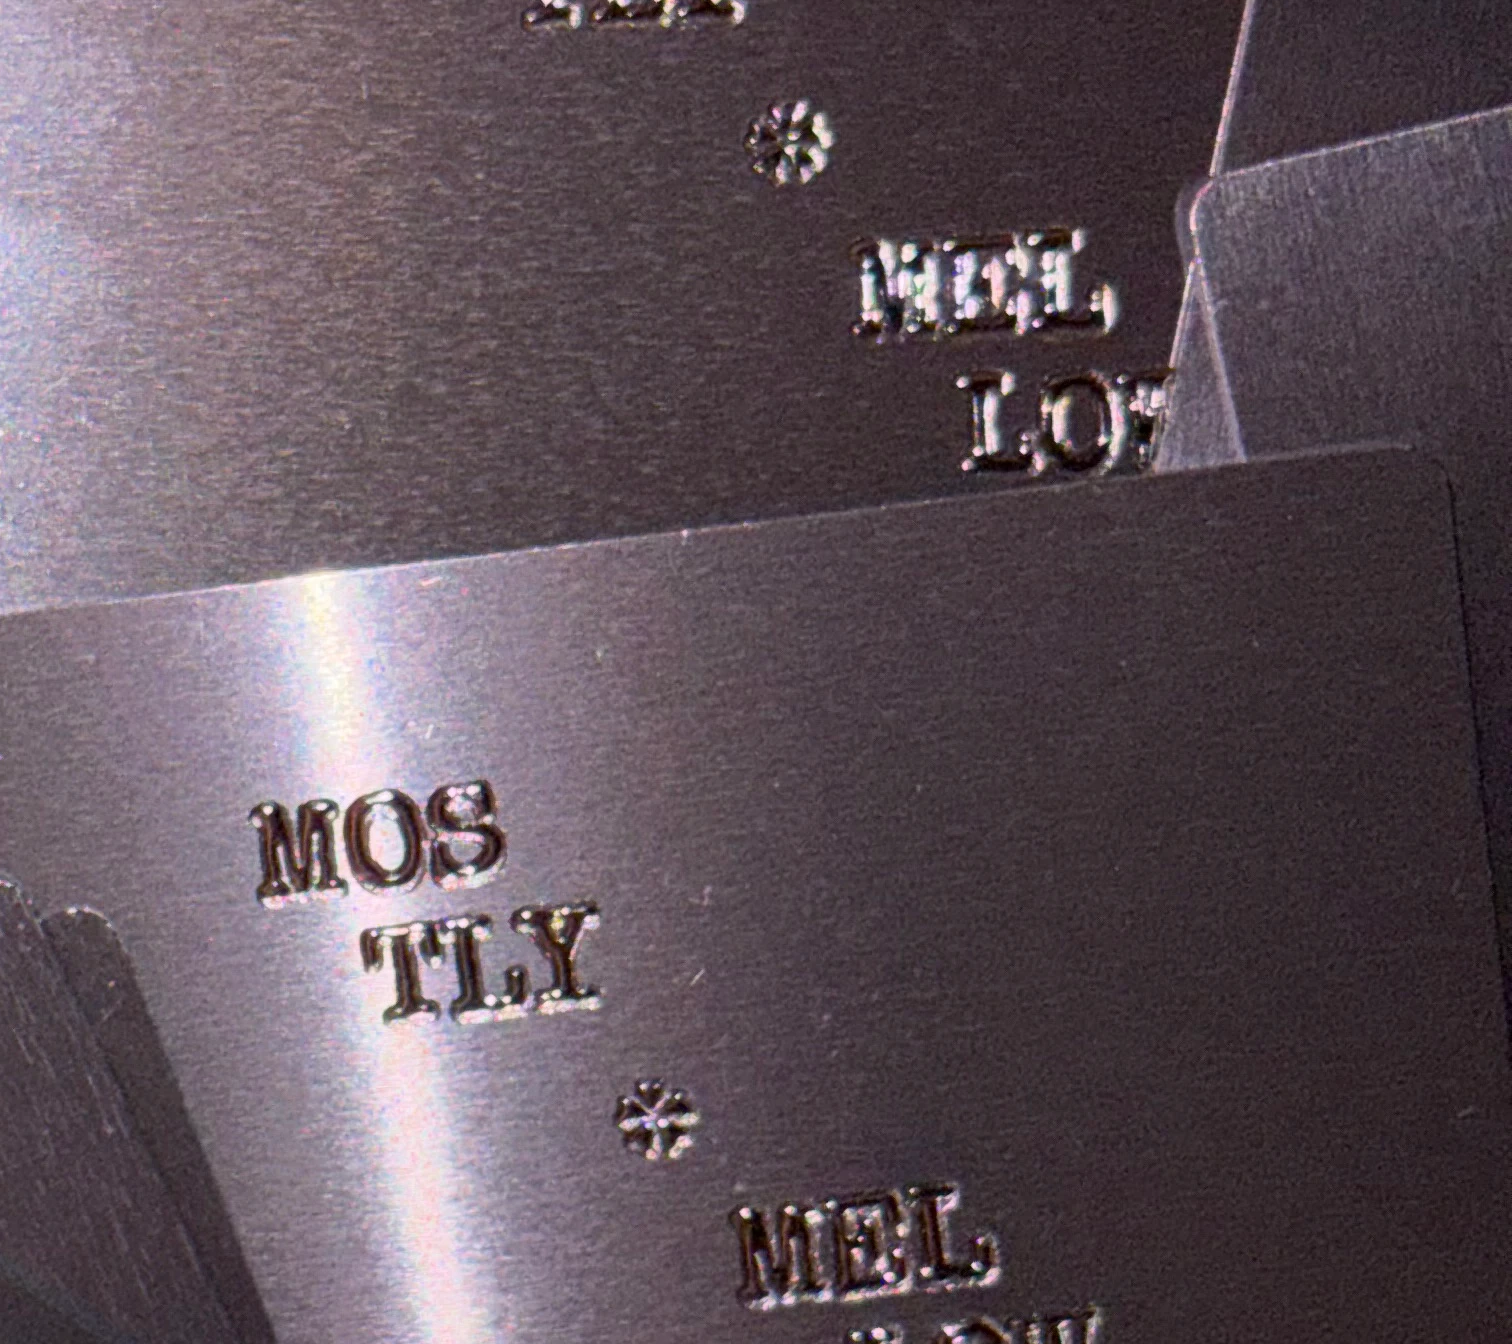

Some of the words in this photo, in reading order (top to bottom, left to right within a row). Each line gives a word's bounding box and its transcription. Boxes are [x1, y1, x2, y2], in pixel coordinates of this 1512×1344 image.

[850, 226, 1122, 342] MEL
[248, 778, 508, 910] MOS
[359, 900, 604, 1026] TLY
[728, 1181, 1003, 1311] MEL
